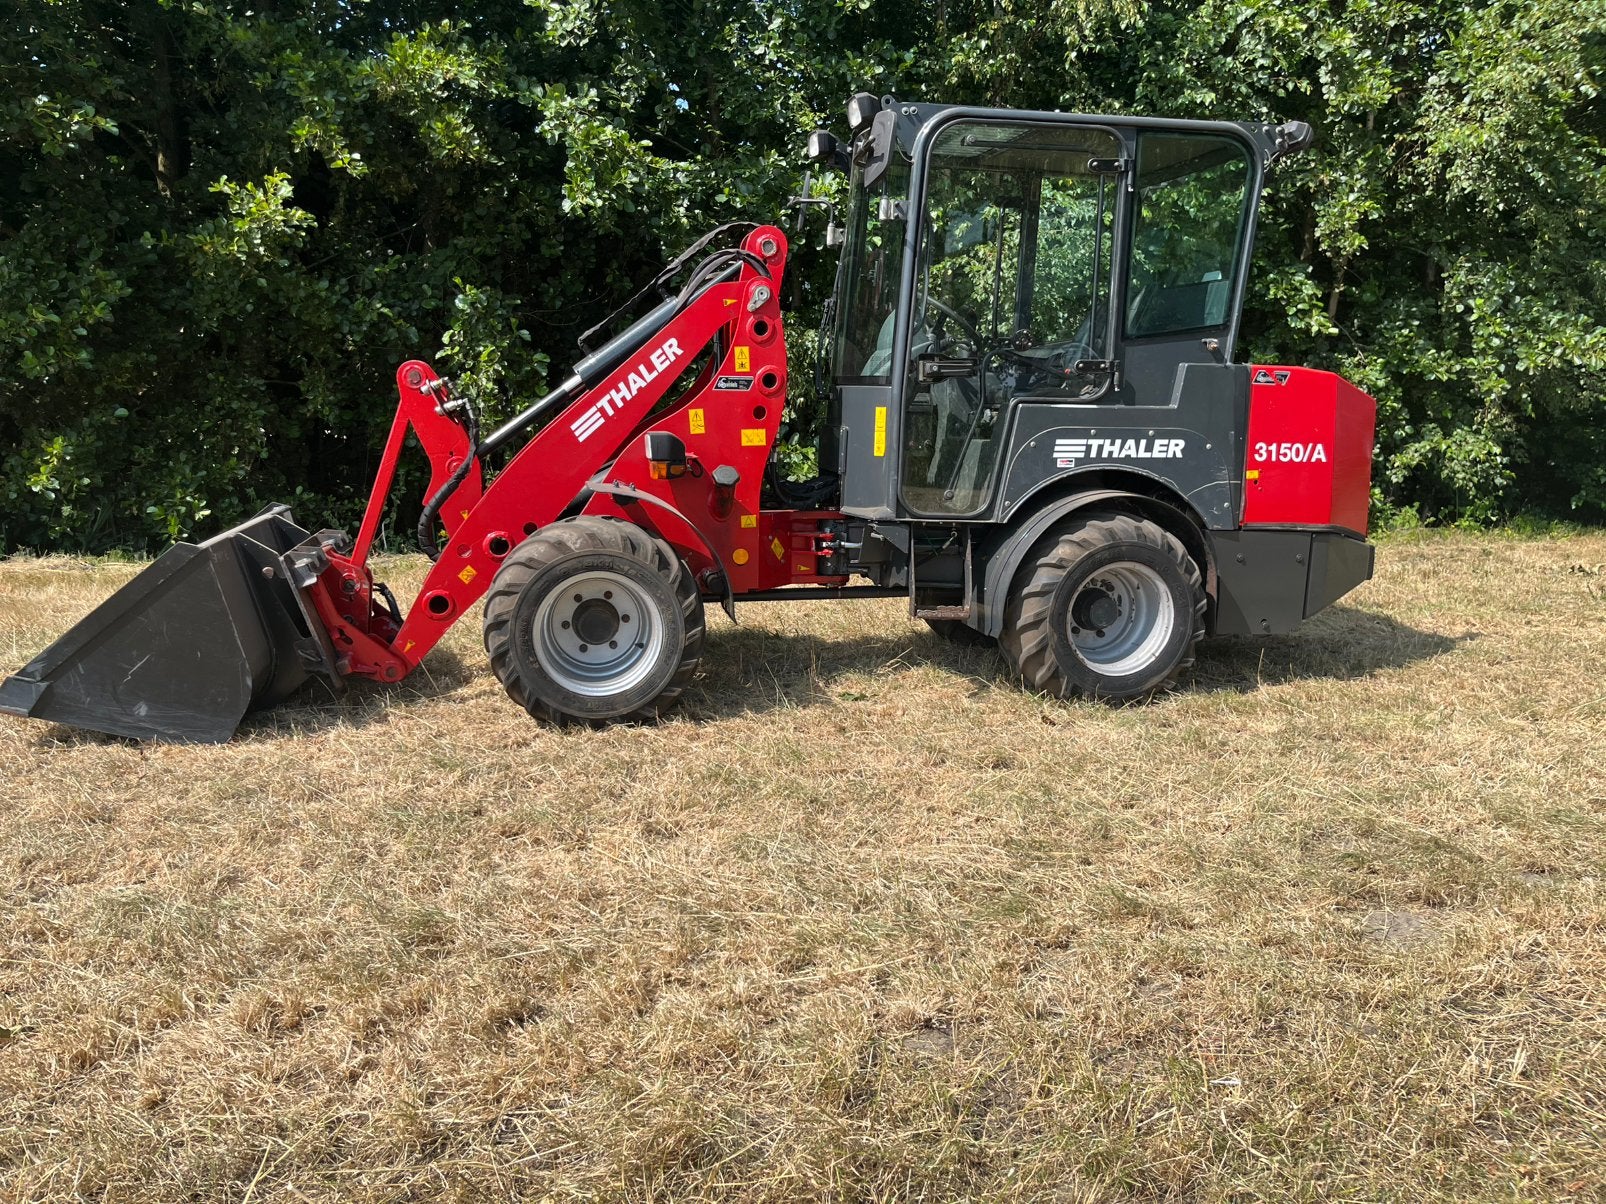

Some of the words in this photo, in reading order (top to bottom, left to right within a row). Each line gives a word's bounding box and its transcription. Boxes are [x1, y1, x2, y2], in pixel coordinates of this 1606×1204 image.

[596, 338, 684, 417] THALER
[1087, 438, 1185, 458] THALER
[1254, 442, 1327, 463] 3150/A
